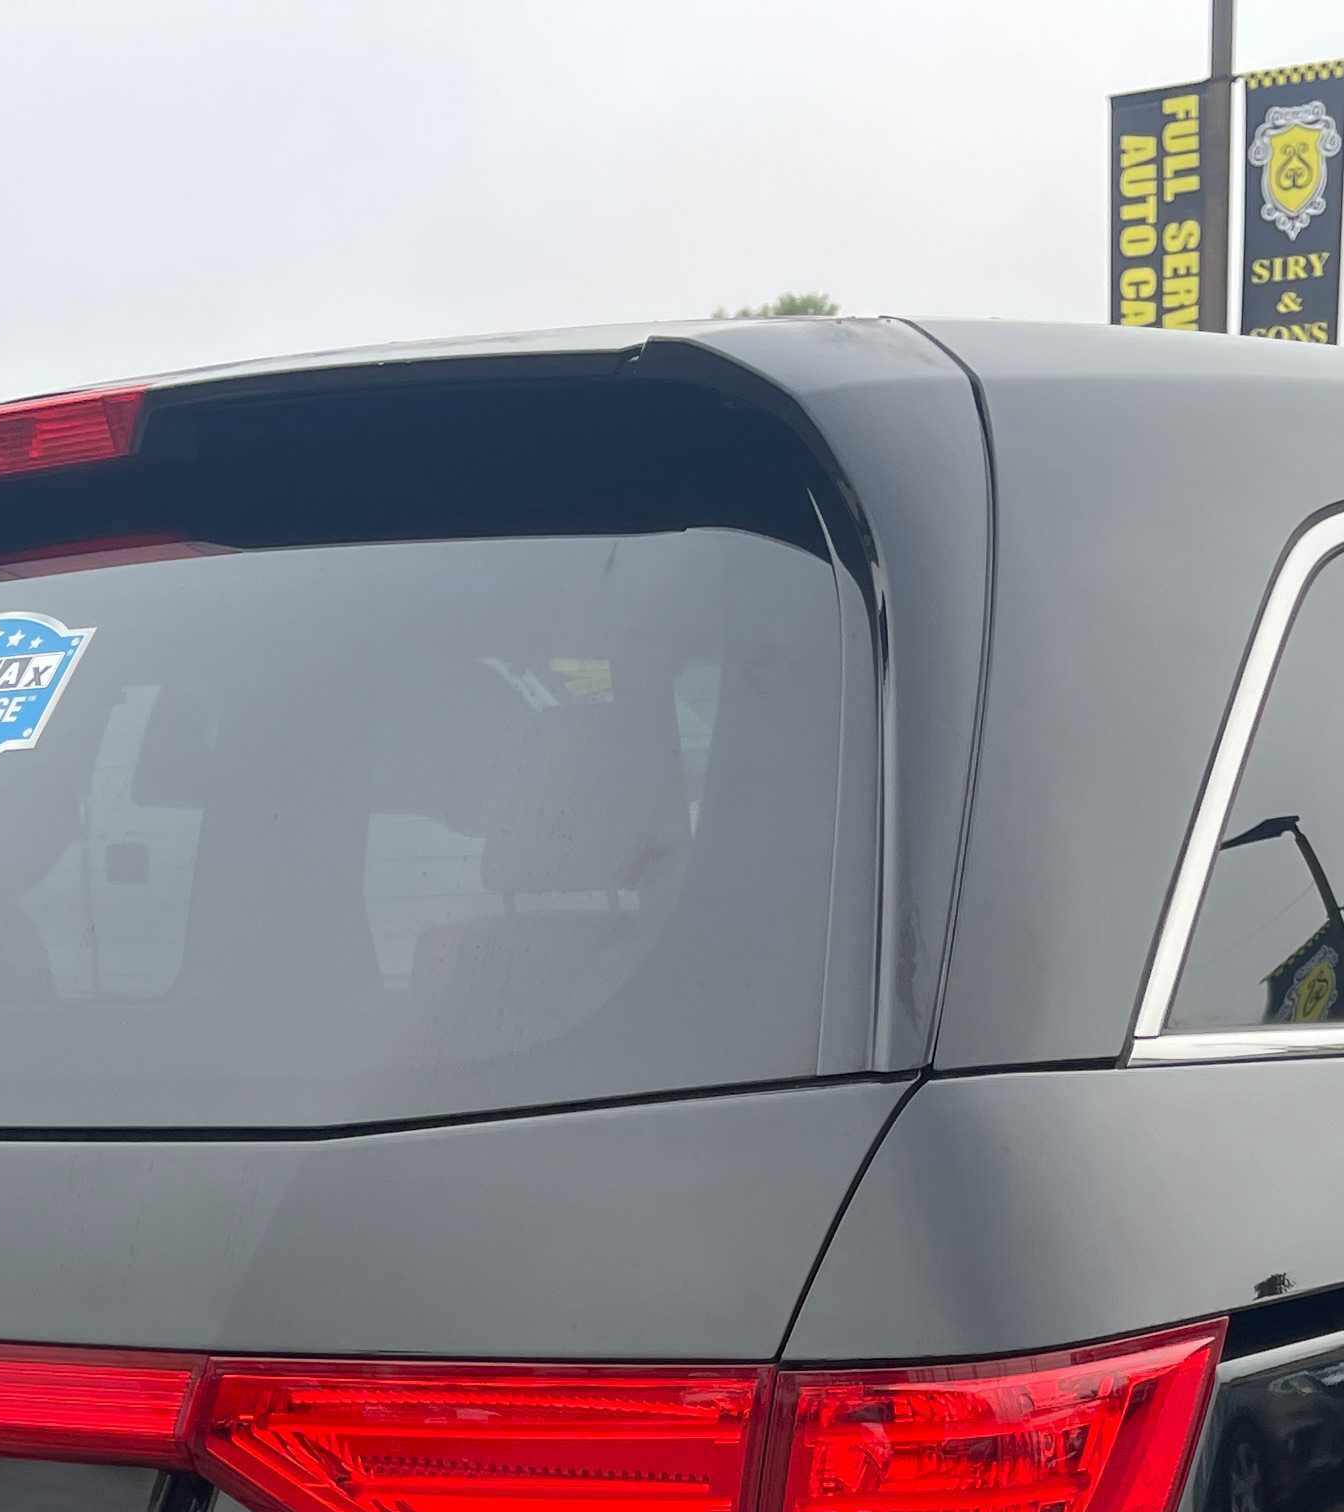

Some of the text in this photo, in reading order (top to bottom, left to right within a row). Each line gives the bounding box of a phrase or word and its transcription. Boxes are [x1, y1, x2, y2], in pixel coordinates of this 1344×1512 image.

[1162, 94, 1200, 202] FULL
[1120, 135, 1157, 258] AUTO
[1251, 252, 1329, 284] SIRY
[1276, 292, 1303, 314] &
